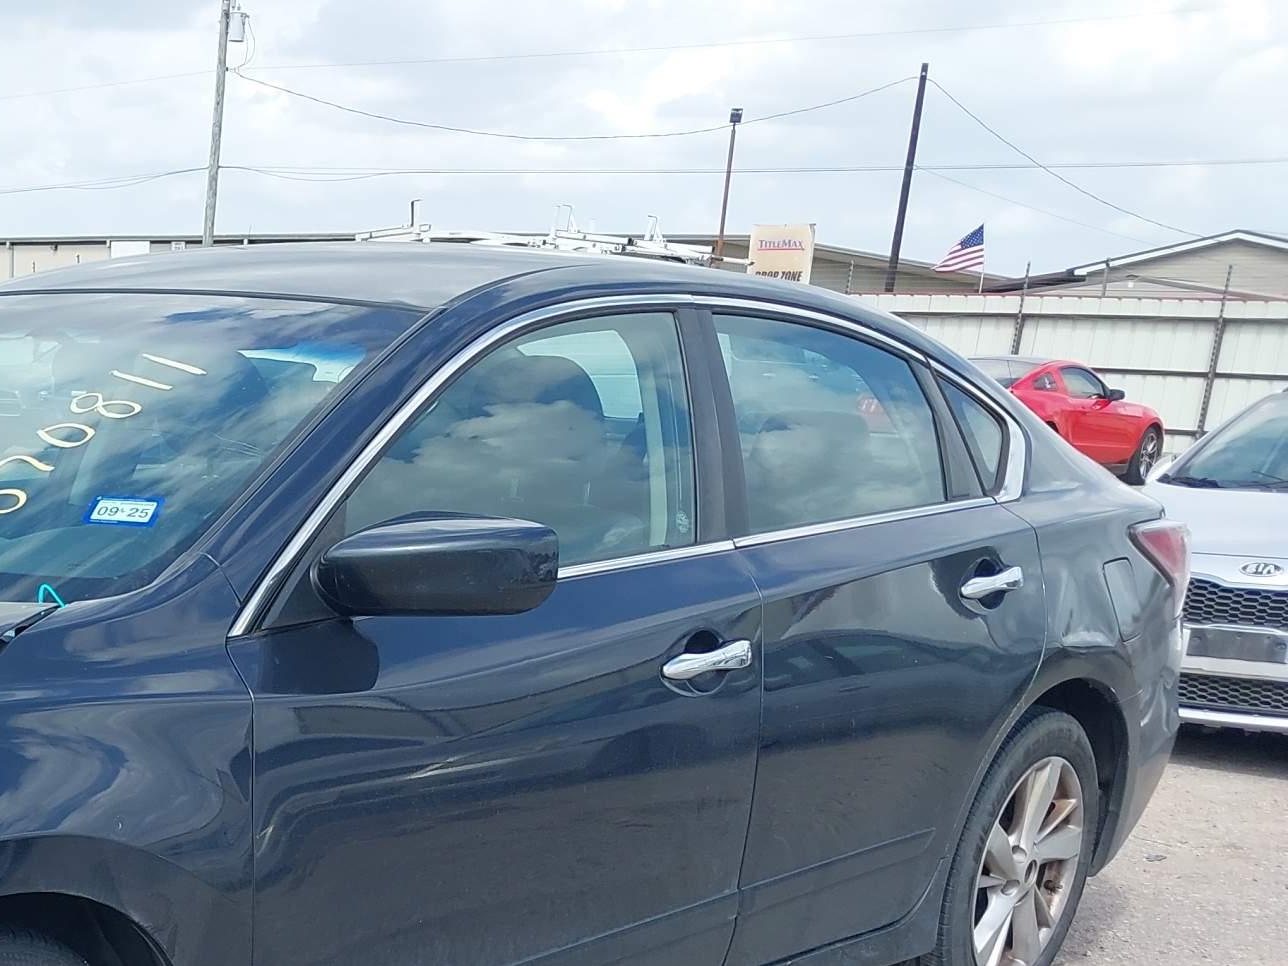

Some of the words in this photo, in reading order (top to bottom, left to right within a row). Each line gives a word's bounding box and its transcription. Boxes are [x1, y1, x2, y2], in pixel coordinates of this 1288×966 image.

[780, 271, 804, 282] ZONE
[96, 505, 120, 517] 09
[125, 507, 152, 519] 25
[1246, 563, 1275, 575] KIA
